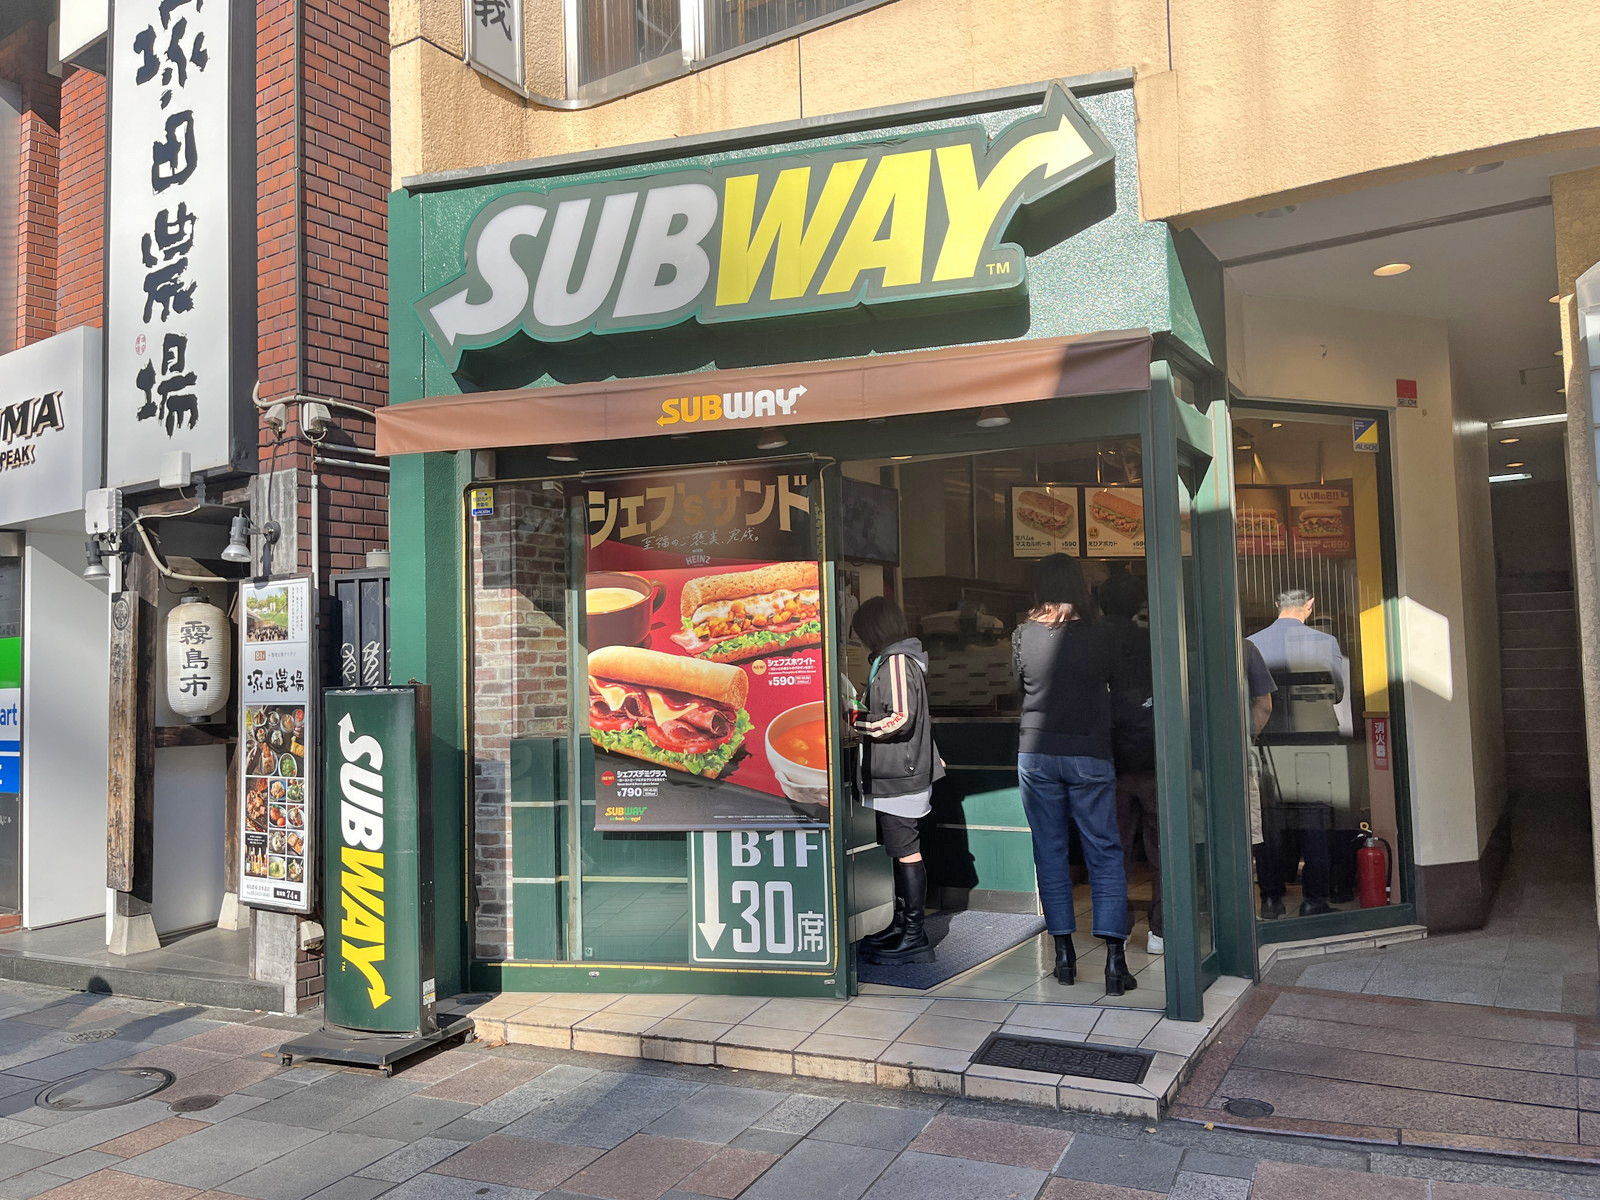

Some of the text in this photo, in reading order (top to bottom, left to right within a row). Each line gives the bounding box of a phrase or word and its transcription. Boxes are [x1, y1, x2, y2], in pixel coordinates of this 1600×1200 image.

[429, 114, 1093, 345] SUBWAY TM
[0, 391, 64, 444] MA
[656, 384, 807, 427] SUBWAY
[1355, 443, 1378, 451] ALSOK
[686, 555, 711, 565] HEINZ
[179, 621, 213, 697] 霧島市
[768, 657, 815, 667] シェフズホワイト
[247, 668, 304, 693] 塚田農場
[768, 676, 795, 686] ¥590
[1375, 721, 1385, 757] 消火器
[617, 770, 667, 778] シェフズデミグラス
[617, 788, 642, 797] ¥790
[605, 806, 648, 816] SUBWAY
[338, 712, 391, 1009] SUBWAY
[731, 829, 819, 867] B1F
[731, 881, 825, 953] 30席
